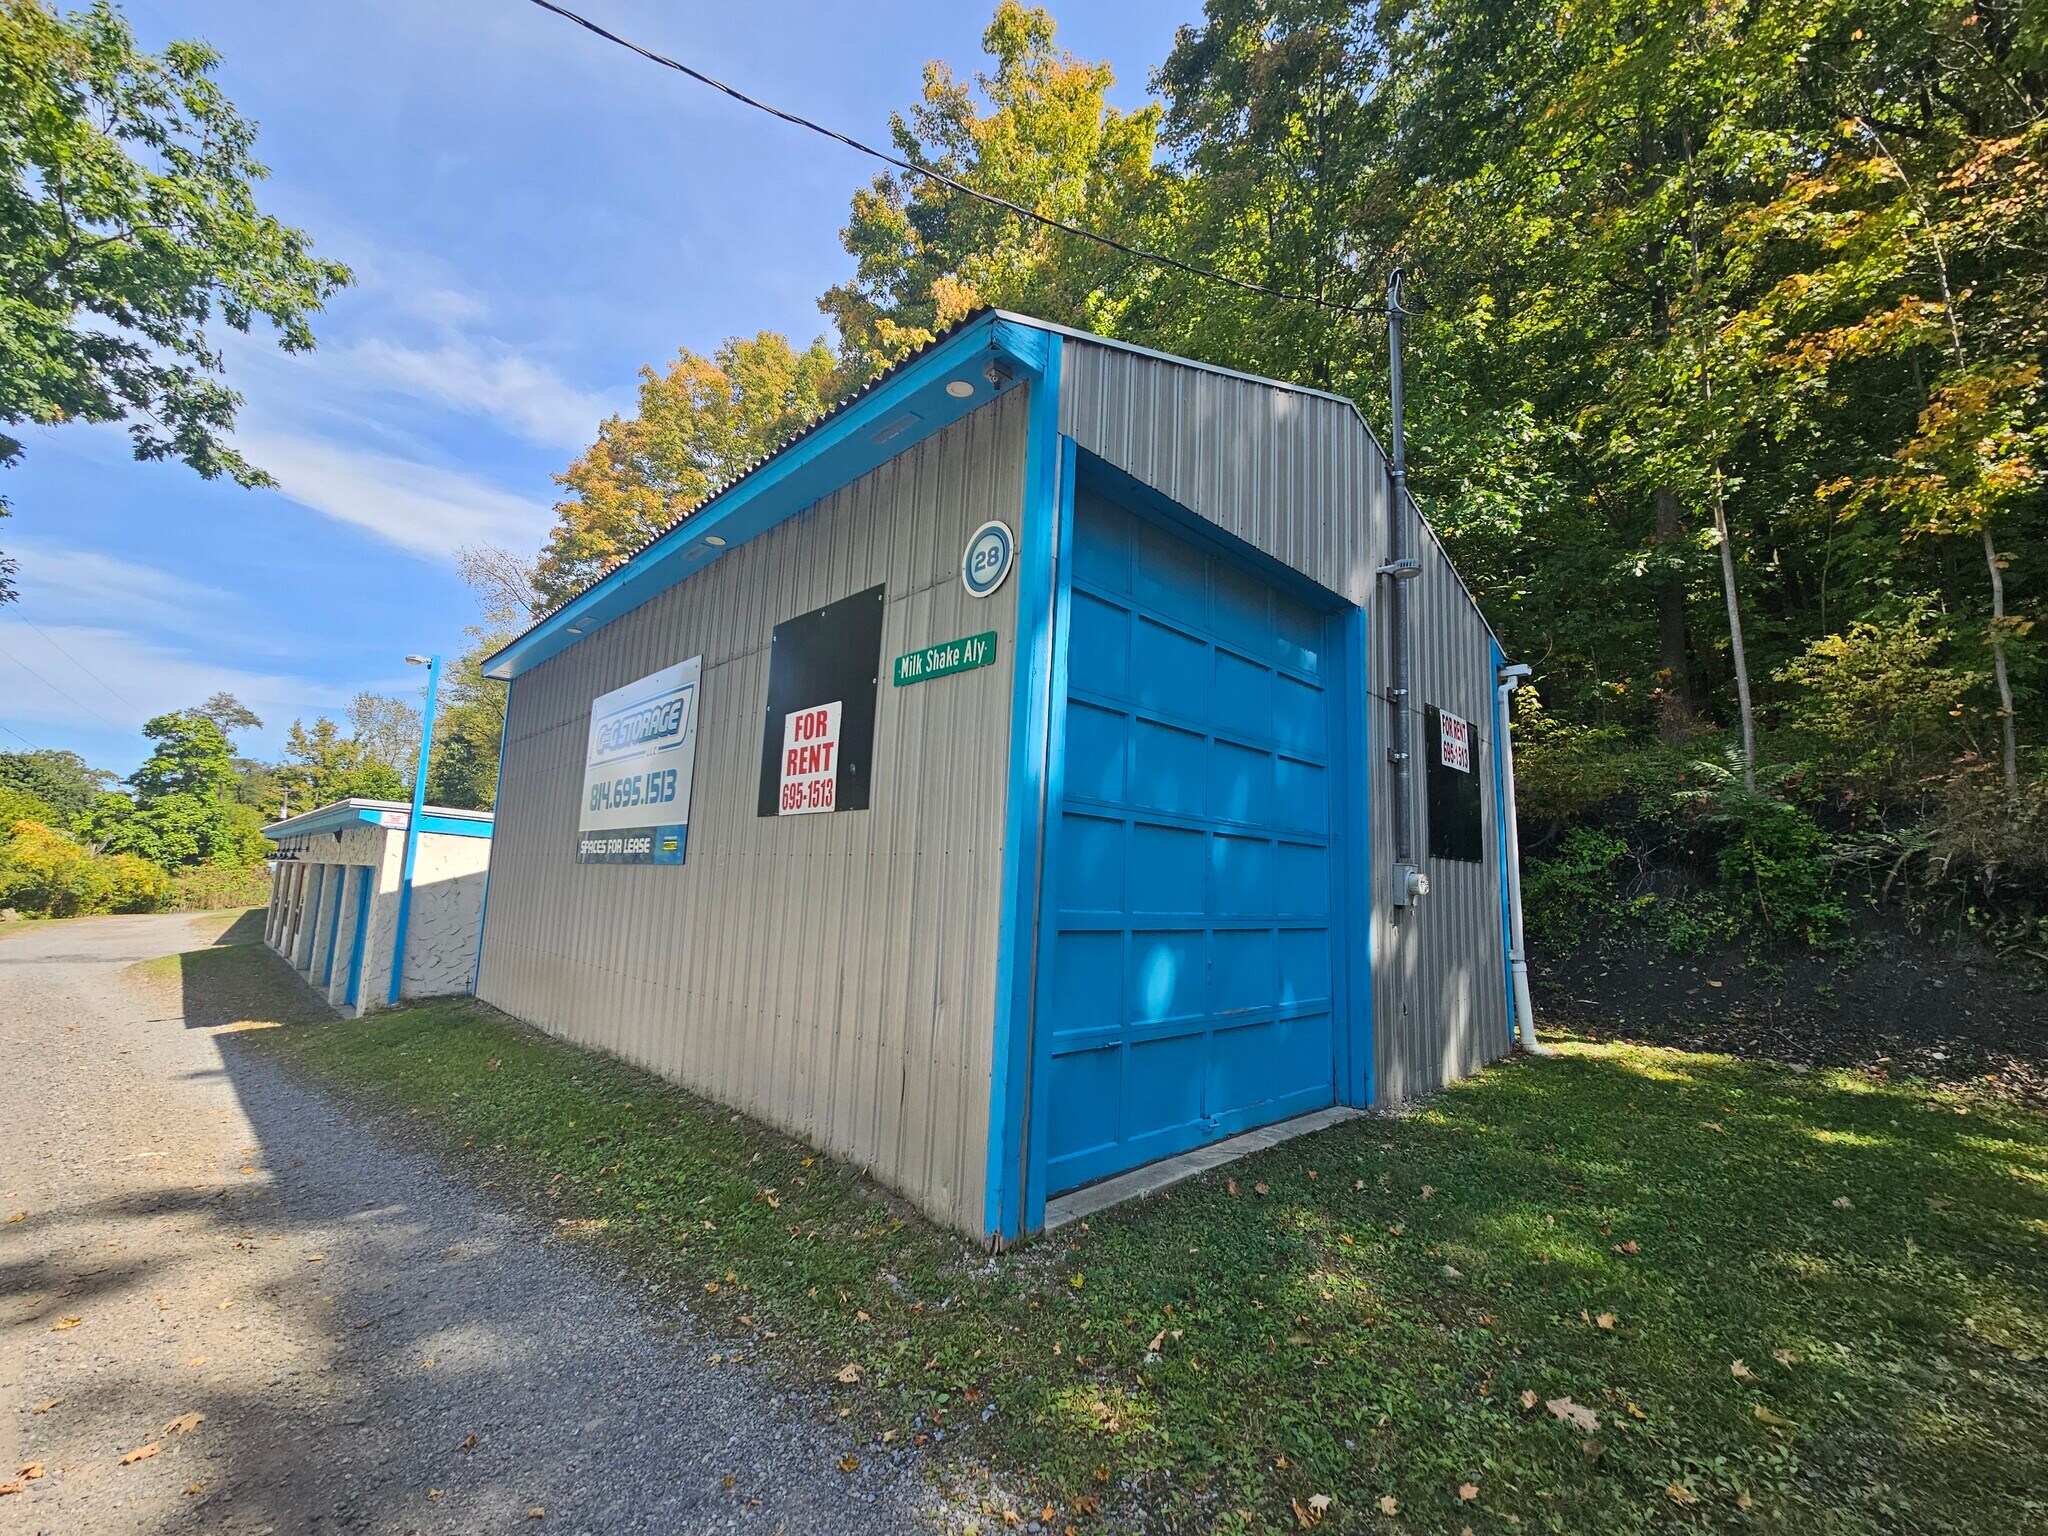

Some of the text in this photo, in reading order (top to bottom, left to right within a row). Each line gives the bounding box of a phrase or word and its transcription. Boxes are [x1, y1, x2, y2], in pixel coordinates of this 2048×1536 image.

[974, 545, 1000, 573] 28
[901, 638, 985, 679] Milk Shake Aly
[620, 699, 684, 745] STORAGE
[794, 710, 828, 742] FOR
[1442, 714, 1466, 743] FOR RENT
[786, 742, 834, 777] RENT
[1443, 740, 1468, 768] 695-1513
[590, 769, 677, 811] 814.695.1513
[782, 778, 833, 811] 695-1513
[580, 840, 607, 854] SPACES
[607, 838, 622, 854] FOR
[623, 837, 651, 854] LEASE
